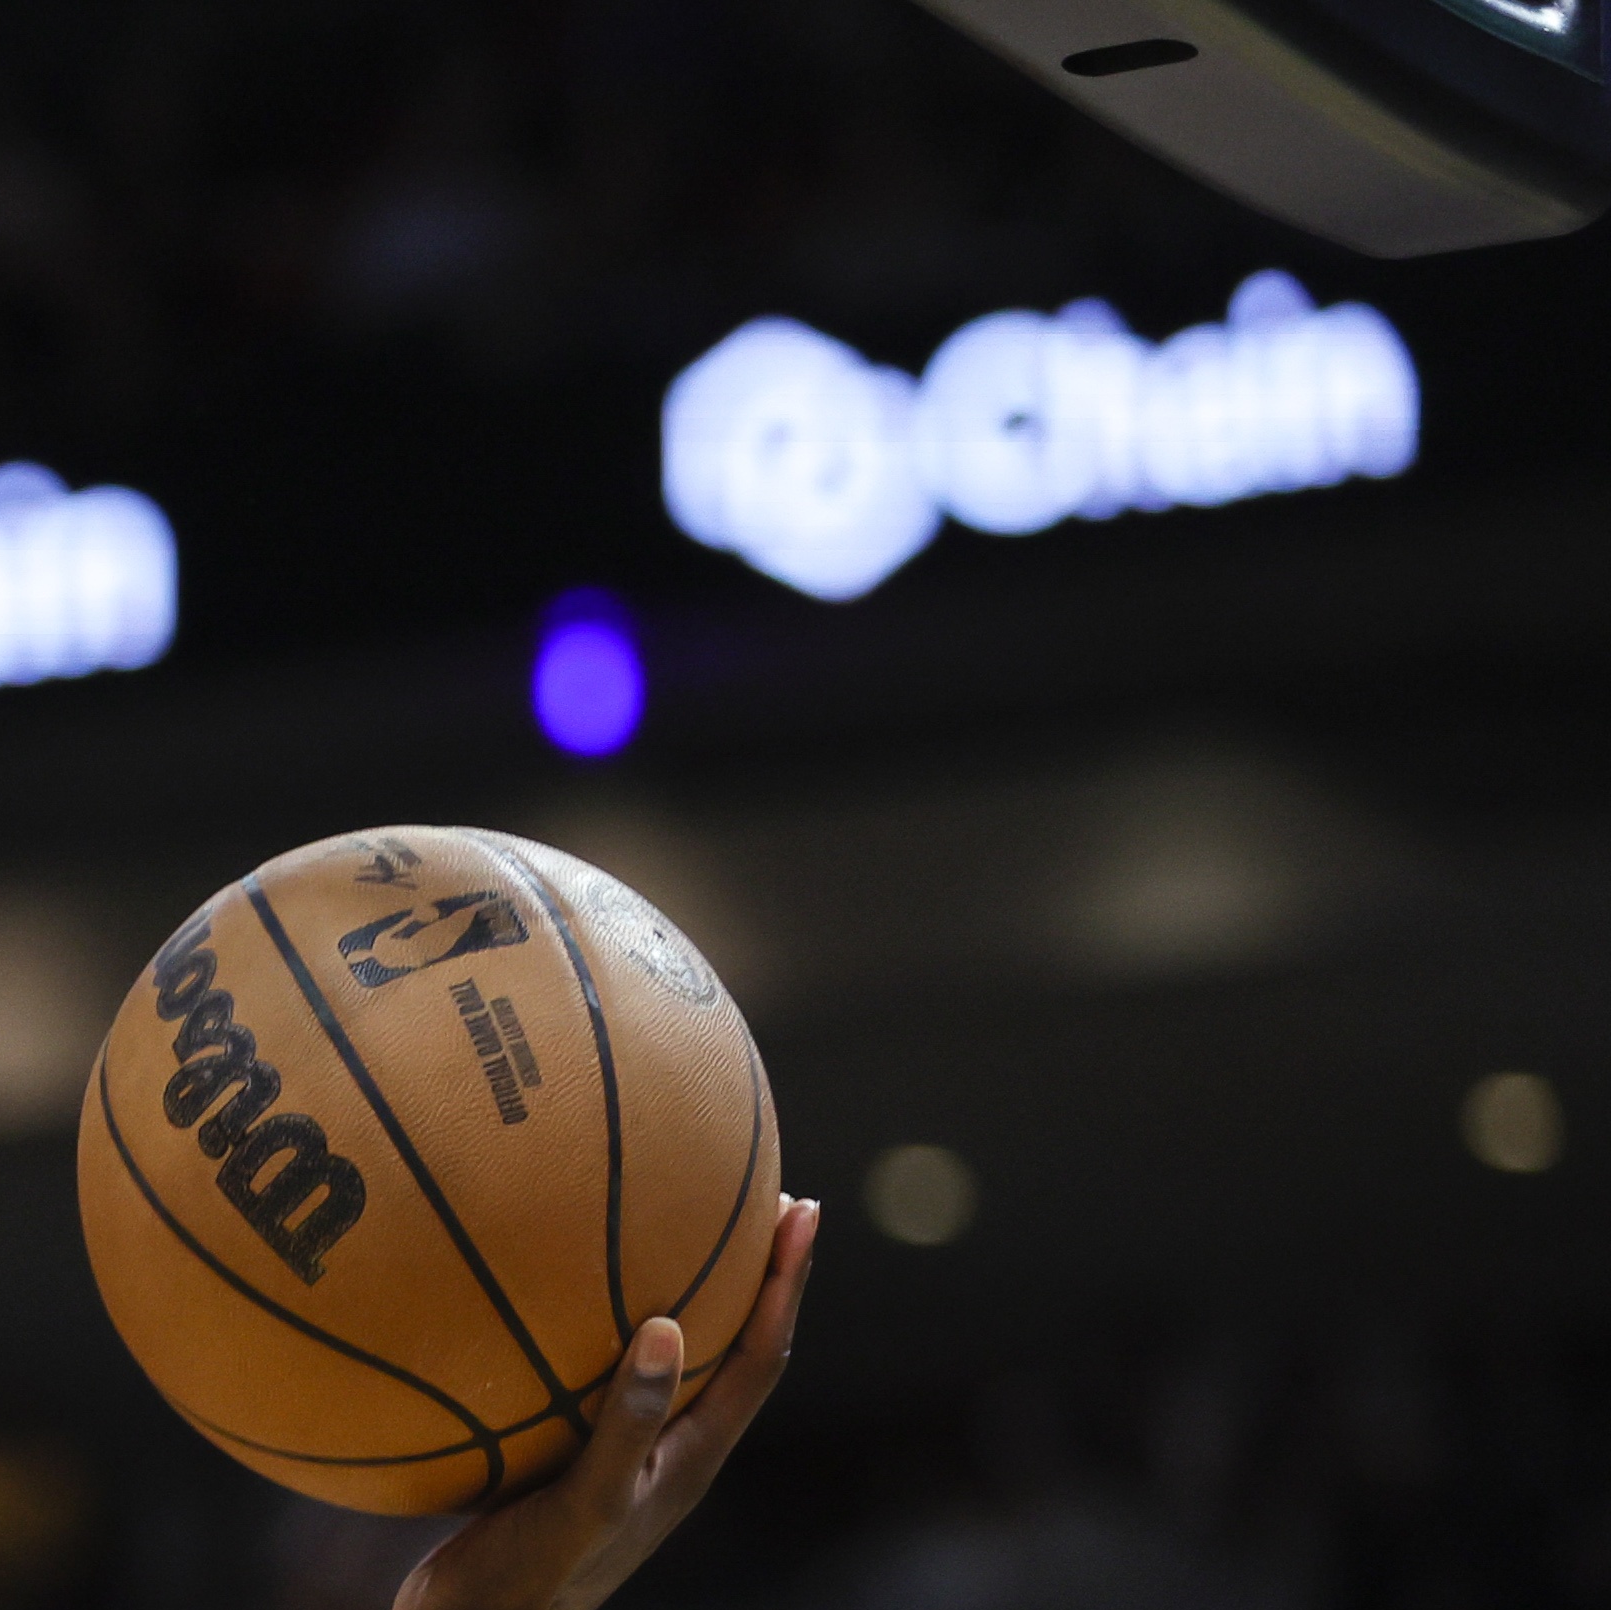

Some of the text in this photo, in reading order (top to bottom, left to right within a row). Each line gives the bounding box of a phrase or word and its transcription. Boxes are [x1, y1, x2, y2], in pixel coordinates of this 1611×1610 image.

[449, 976, 485, 1016] BALL
[464, 1010, 503, 1057] GAME
[483, 1054, 528, 1125] OFFICIAL
